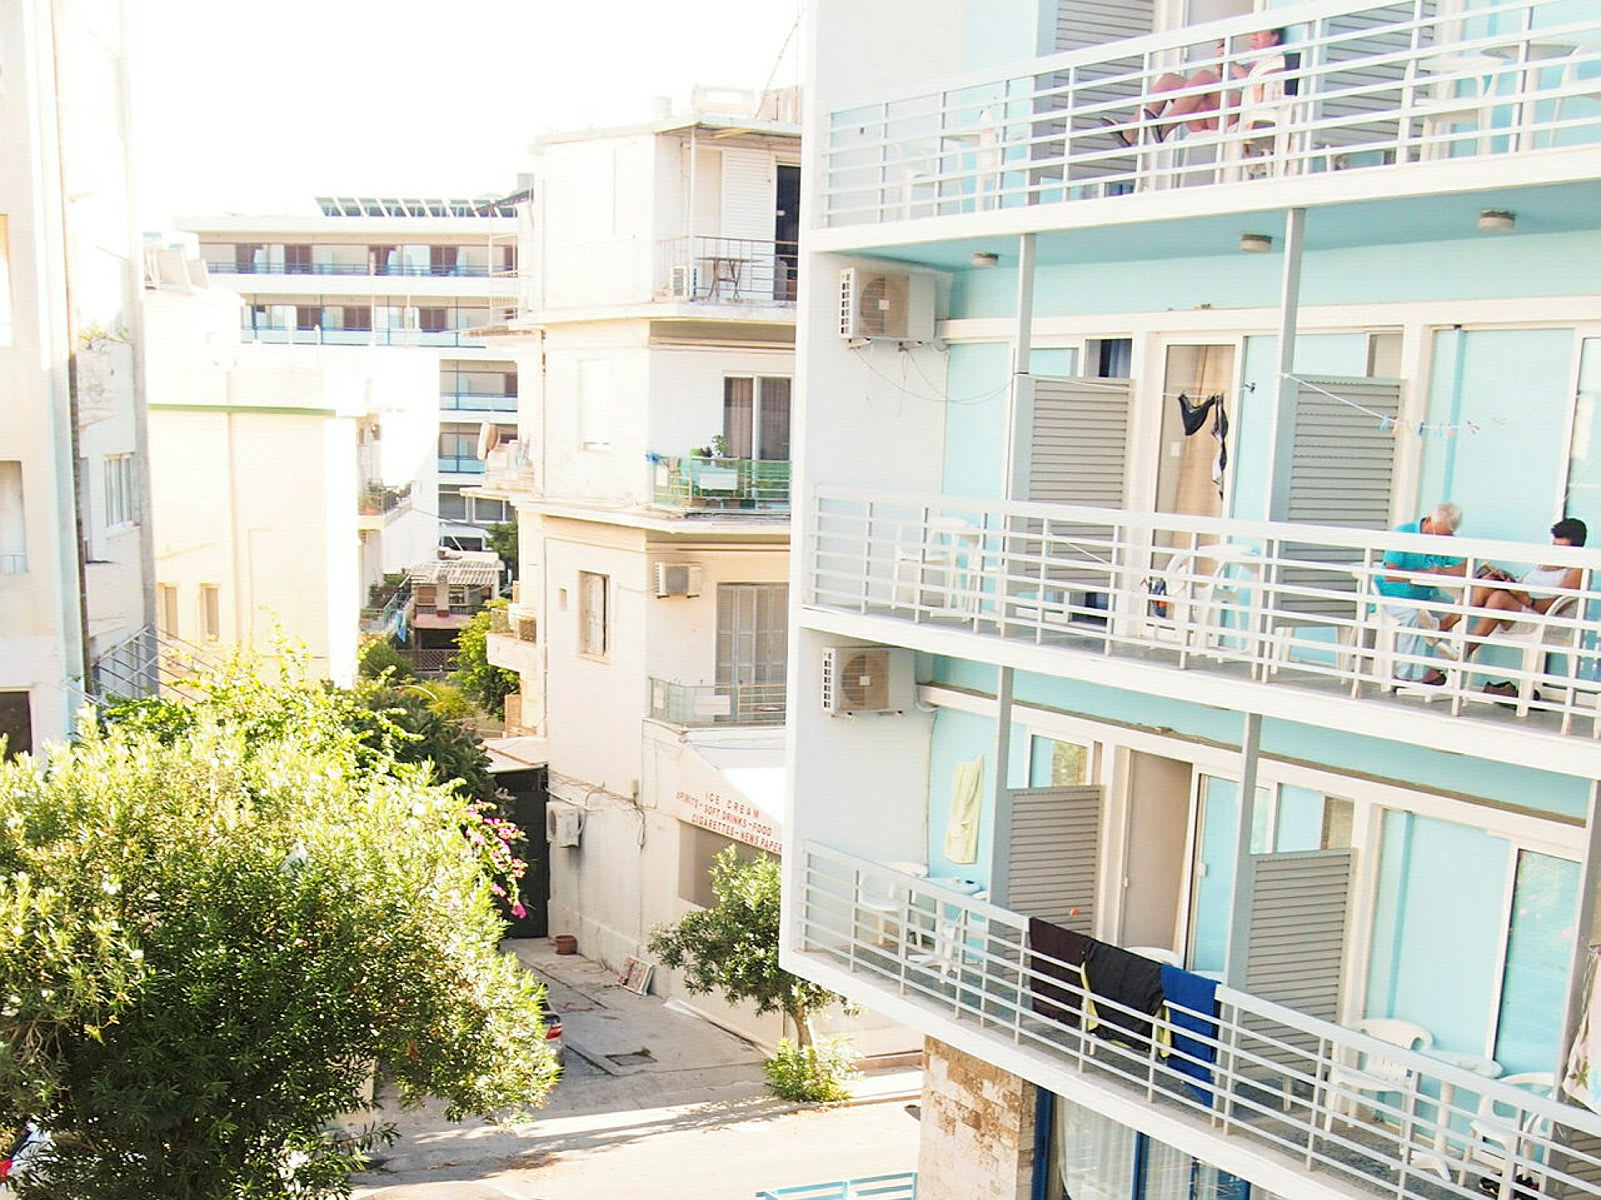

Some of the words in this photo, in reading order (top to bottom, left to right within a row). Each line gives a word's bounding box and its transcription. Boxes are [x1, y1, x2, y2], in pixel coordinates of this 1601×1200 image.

[705, 792, 720, 805] ICE
[727, 800, 760, 818] CREAM
[692, 813, 734, 836] CIGARETTES
[704, 804, 720, 818] SOFT
[722, 811, 747, 828] DRINKS
[752, 822, 773, 837] FOOD
